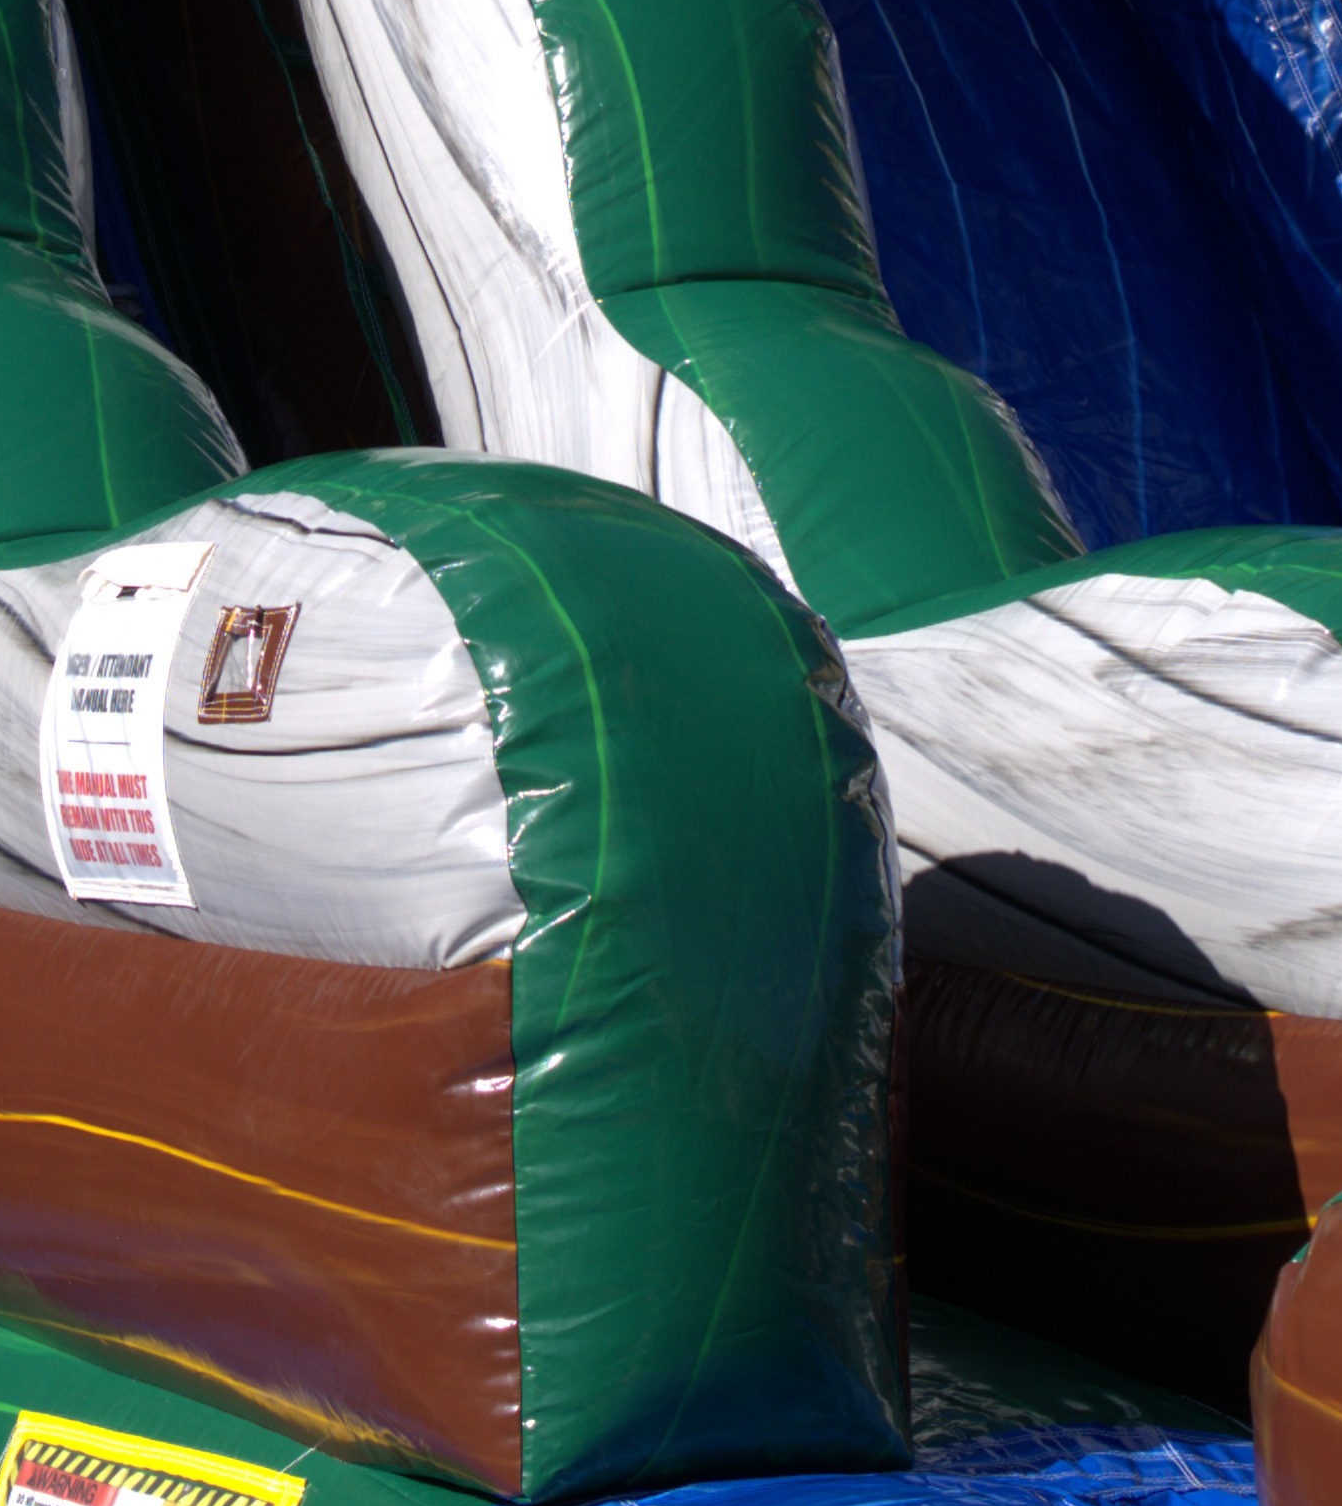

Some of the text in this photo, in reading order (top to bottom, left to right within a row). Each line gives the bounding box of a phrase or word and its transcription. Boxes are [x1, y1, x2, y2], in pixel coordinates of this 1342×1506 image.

[97, 654, 153, 678] ATTENDANT
[71, 688, 135, 713] MANUAL HERE
[57, 770, 147, 800] THE MANUAL MUST
[60, 804, 155, 834] REMAIN WITH THIS
[69, 838, 162, 868] RIDE AT ALL TIMES
[35, 1468, 98, 1505] WARNING
